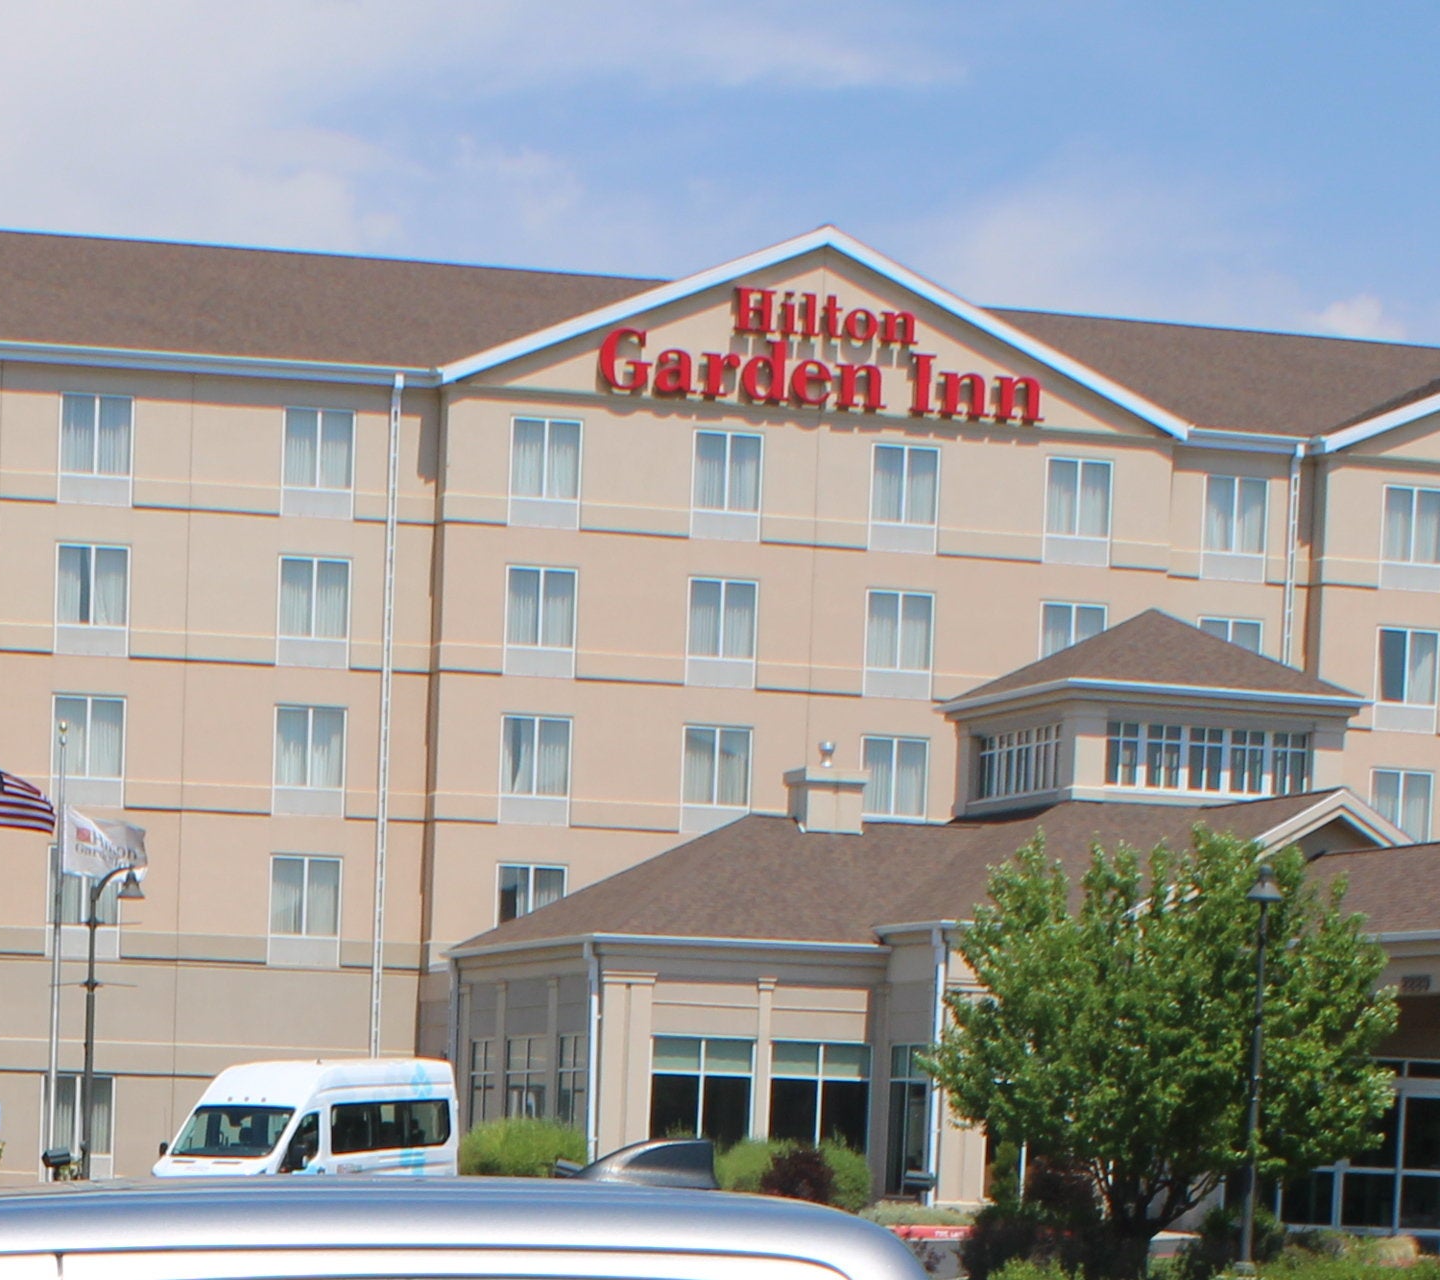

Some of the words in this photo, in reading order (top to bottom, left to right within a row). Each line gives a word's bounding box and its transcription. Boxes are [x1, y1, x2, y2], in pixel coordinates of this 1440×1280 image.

[734, 286, 918, 346] Hilton
[598, 327, 886, 411] Garden
[909, 352, 1045, 423] Inn
